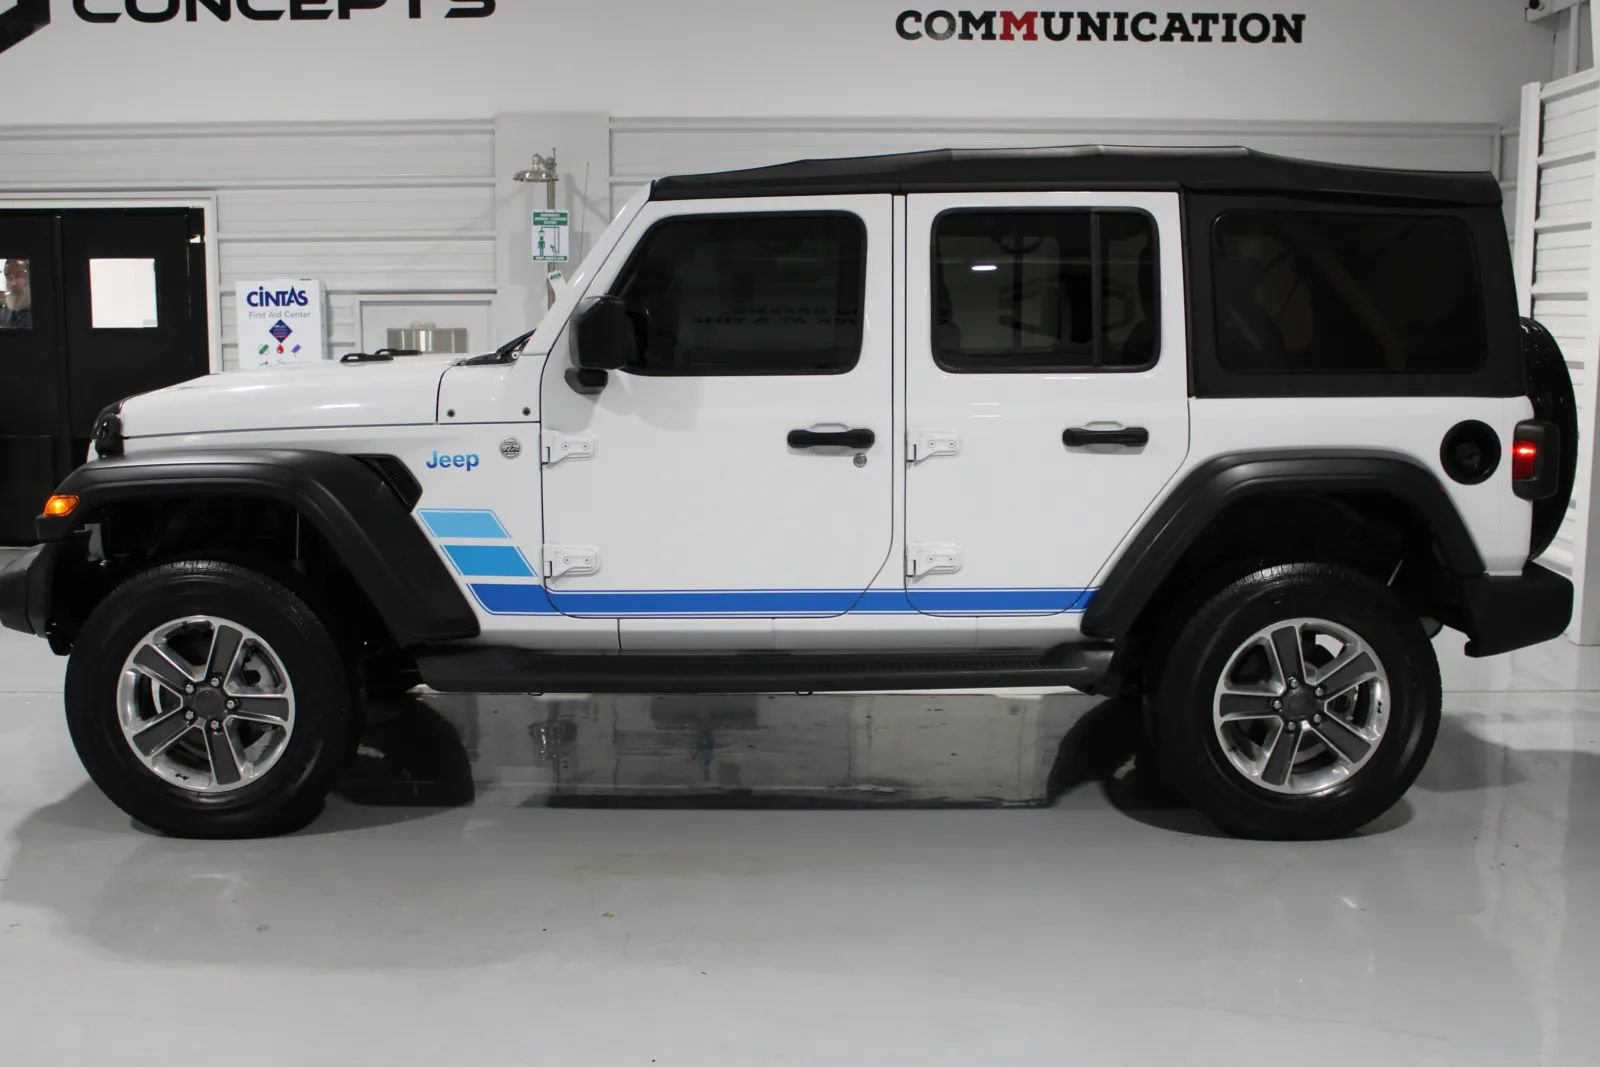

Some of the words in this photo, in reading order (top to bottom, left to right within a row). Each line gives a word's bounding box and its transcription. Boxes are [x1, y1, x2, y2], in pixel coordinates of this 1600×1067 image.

[895, 10, 1307, 43] COMMUNICATION
[248, 311, 266, 319] First
[268, 310, 282, 318] Aid
[284, 310, 311, 318] Center
[425, 449, 480, 472] Jeep
